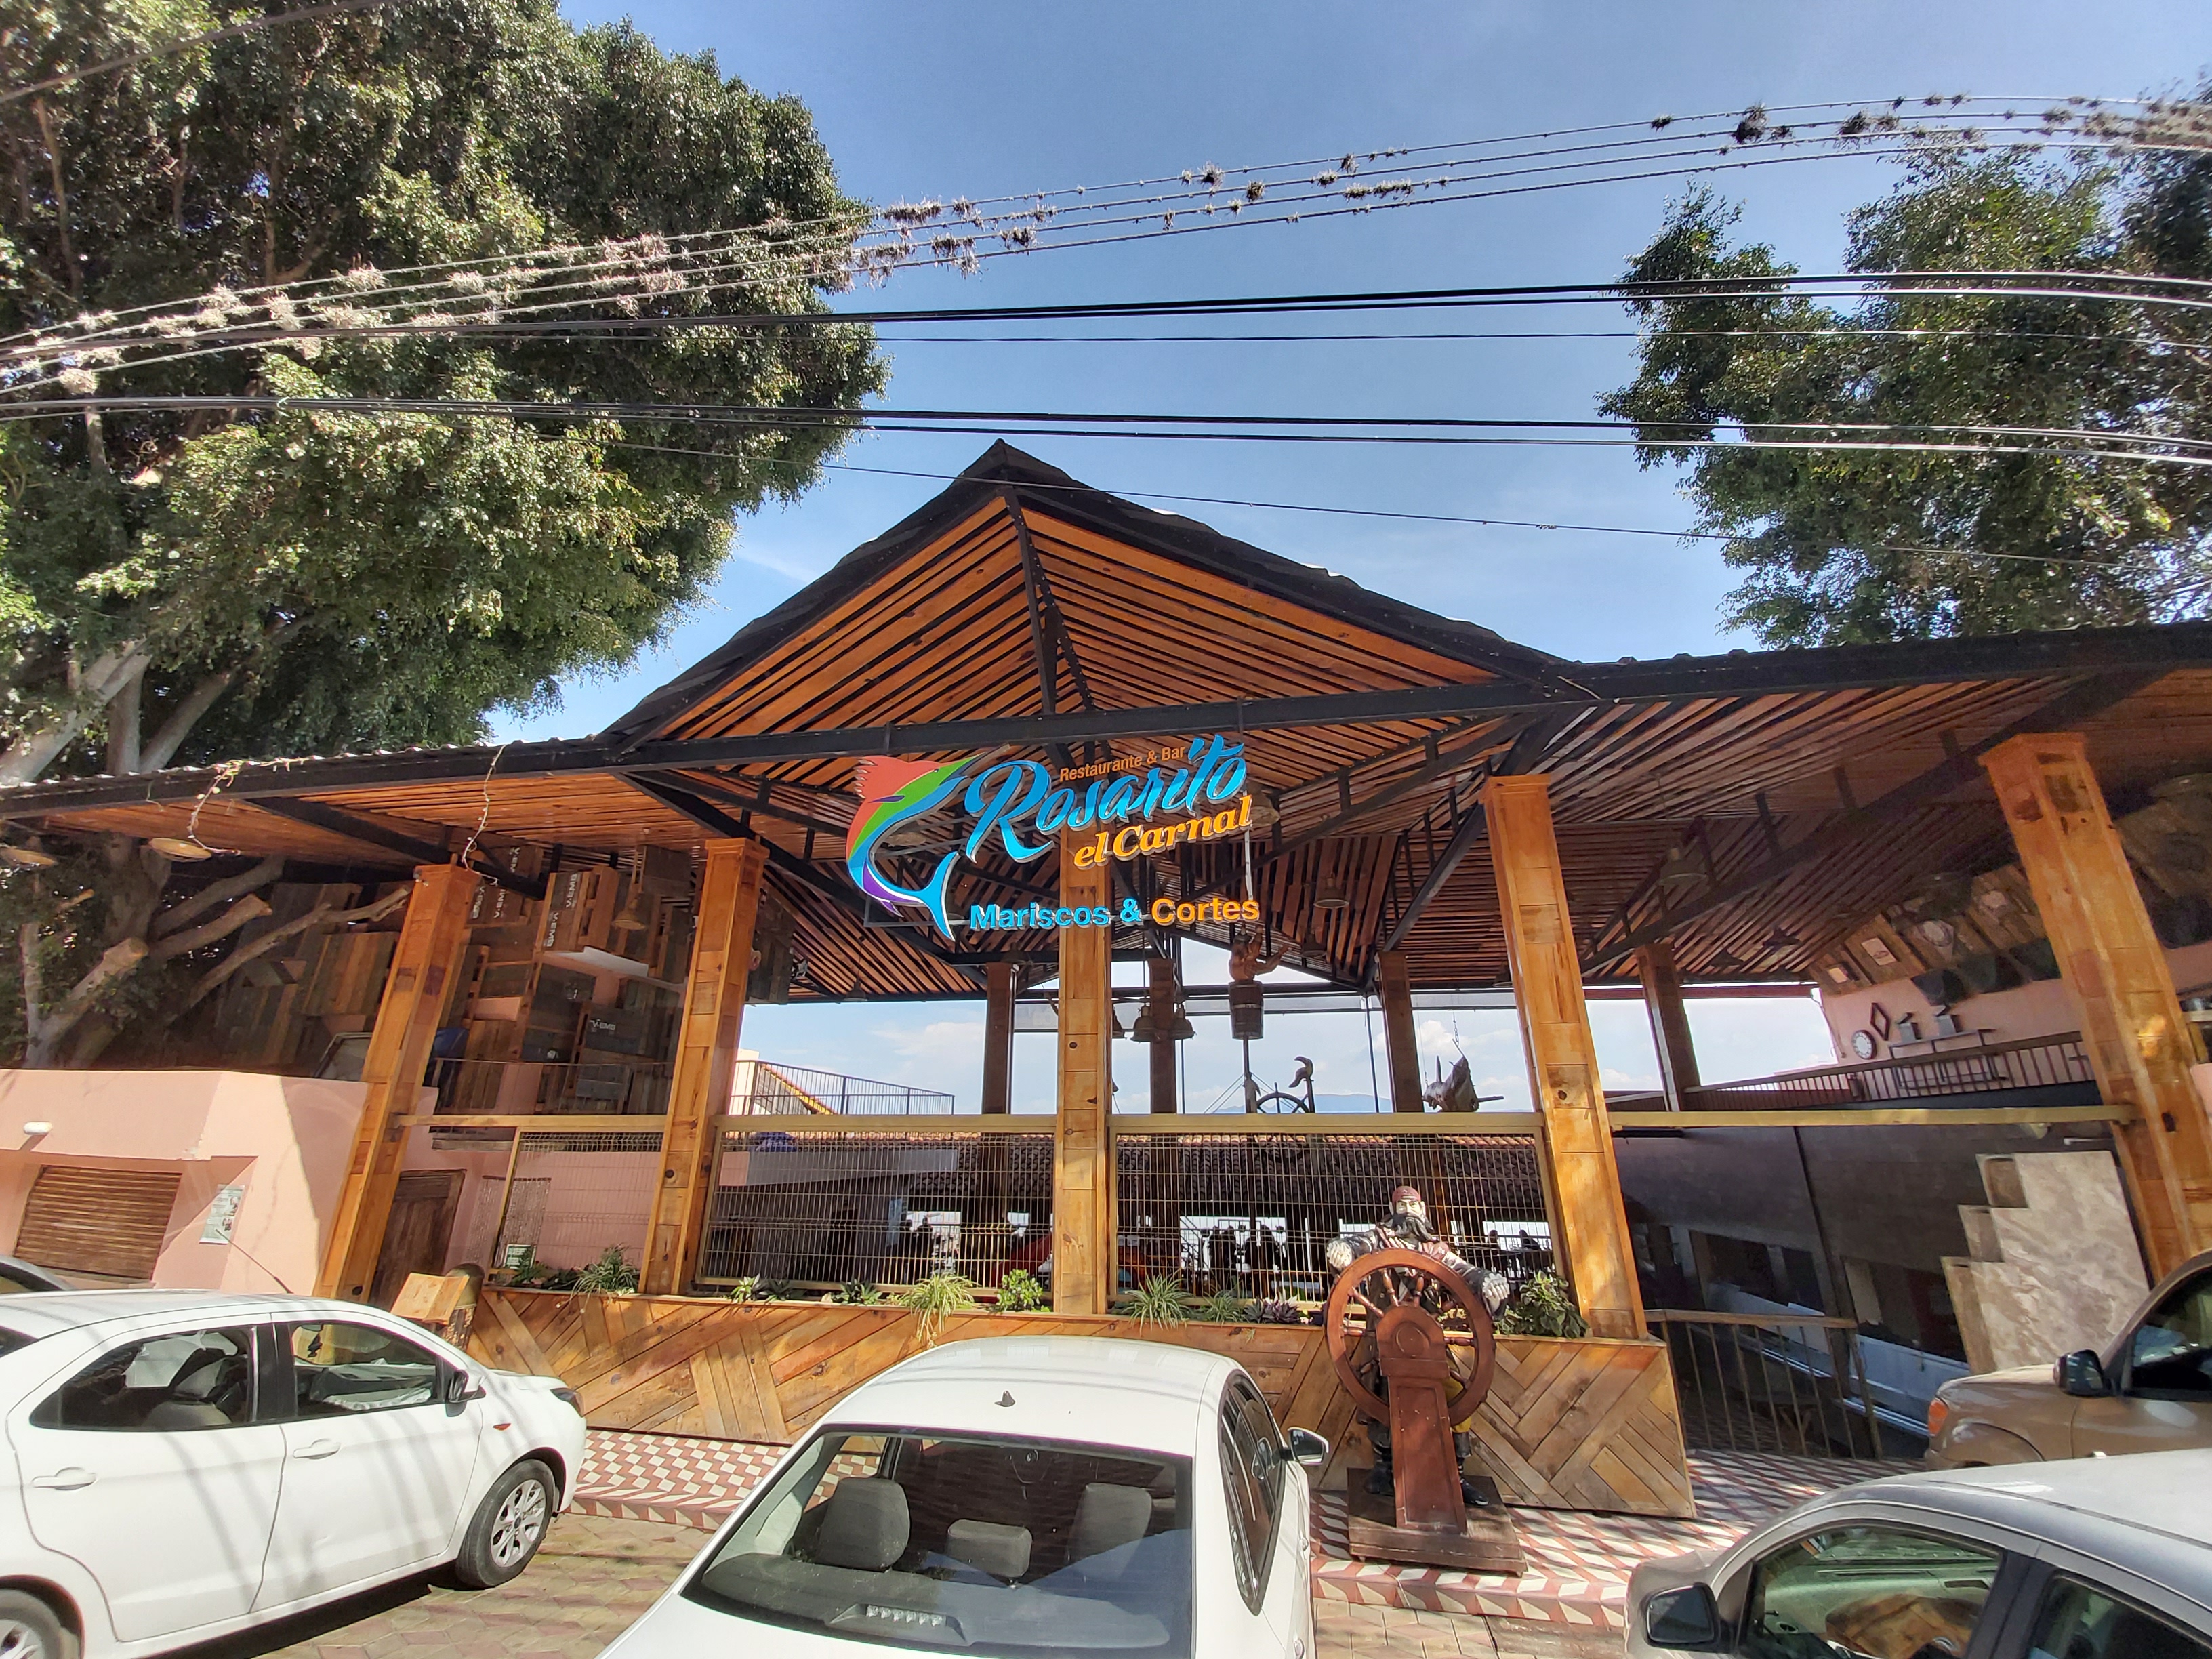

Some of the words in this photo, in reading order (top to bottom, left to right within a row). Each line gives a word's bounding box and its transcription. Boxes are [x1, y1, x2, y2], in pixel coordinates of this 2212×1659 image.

[1059, 754, 1143, 783] Restaurante
[1147, 750, 1158, 764] &
[1162, 747, 1186, 762] Bar
[964, 734, 1248, 862] Rosarito
[1073, 831, 1109, 868] el
[1113, 794, 1252, 859] Carnal
[970, 901, 1111, 930] Mariscos
[1120, 897, 1142, 926] &
[1151, 897, 1259, 926] Cortes
